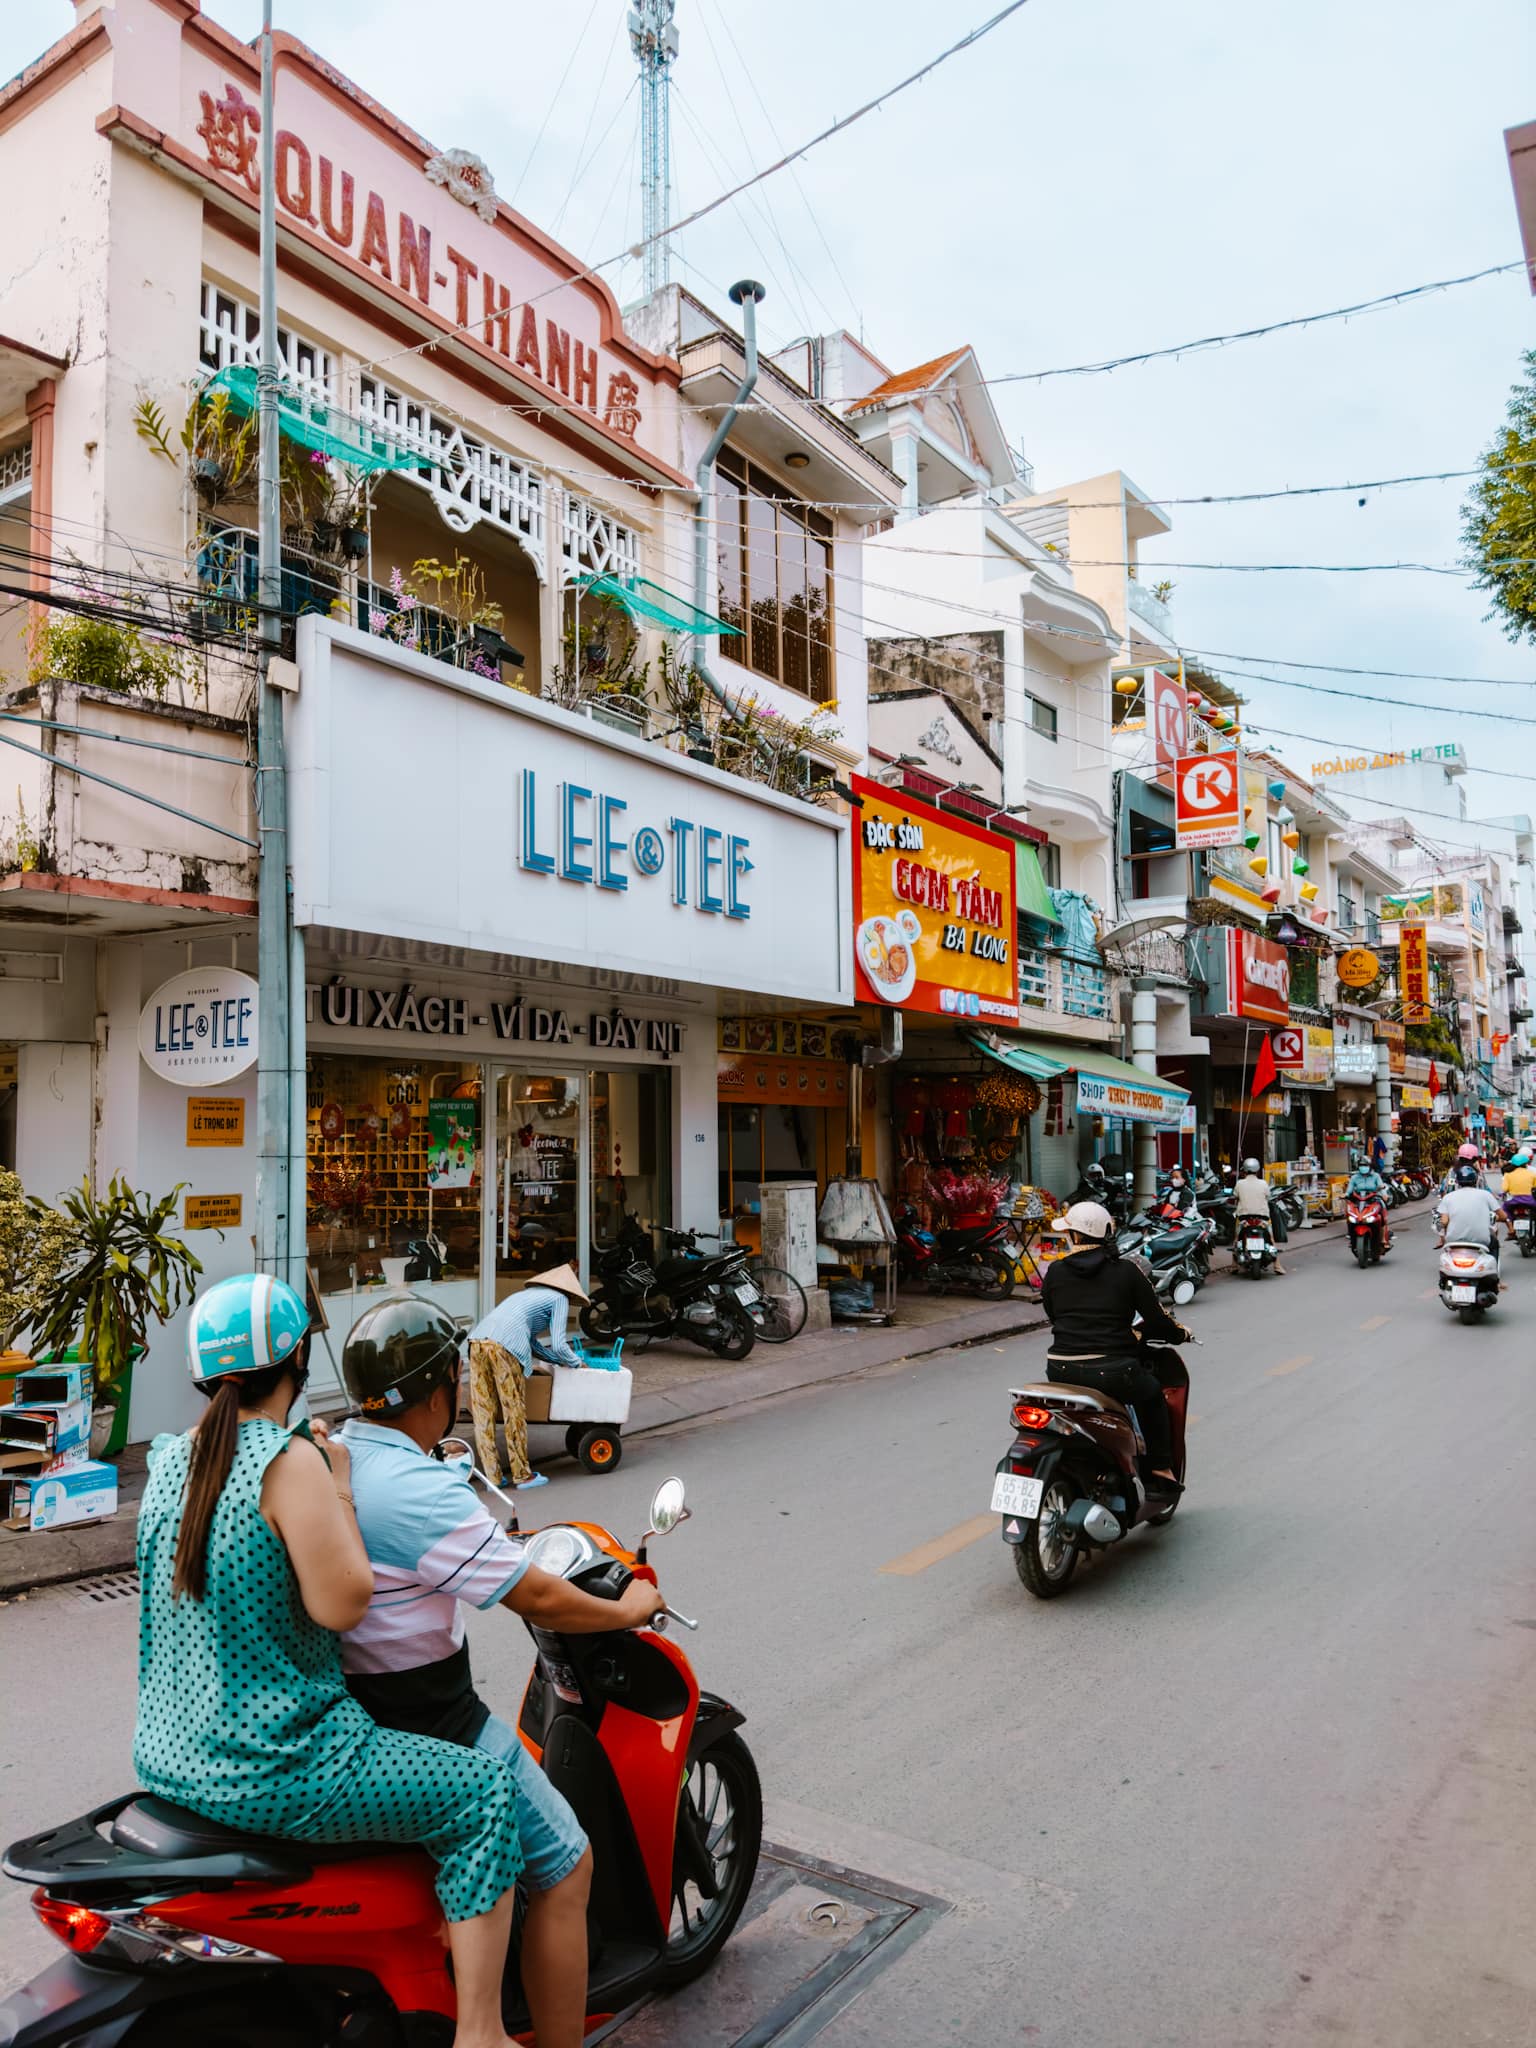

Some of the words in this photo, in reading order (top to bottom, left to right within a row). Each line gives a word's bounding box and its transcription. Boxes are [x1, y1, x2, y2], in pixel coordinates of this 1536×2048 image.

[1311, 756, 1367, 777] HOÀNG
[1371, 751, 1406, 769] ANH
[1411, 743, 1459, 762] HOTEL
[520, 768, 628, 892] LEE
[668, 815, 756, 920] TEE
[973, 930, 1008, 964] LONG
[155, 1003, 195, 1052] LEE
[210, 998, 253, 1049] TEE
[370, 984, 469, 1035] XÁCH
[532, 1007, 573, 1044] DA
[594, 1009, 643, 1050] DÂY
[1280, 1037, 1300, 1056] K
[1080, 1081, 1105, 1100] SHOP
